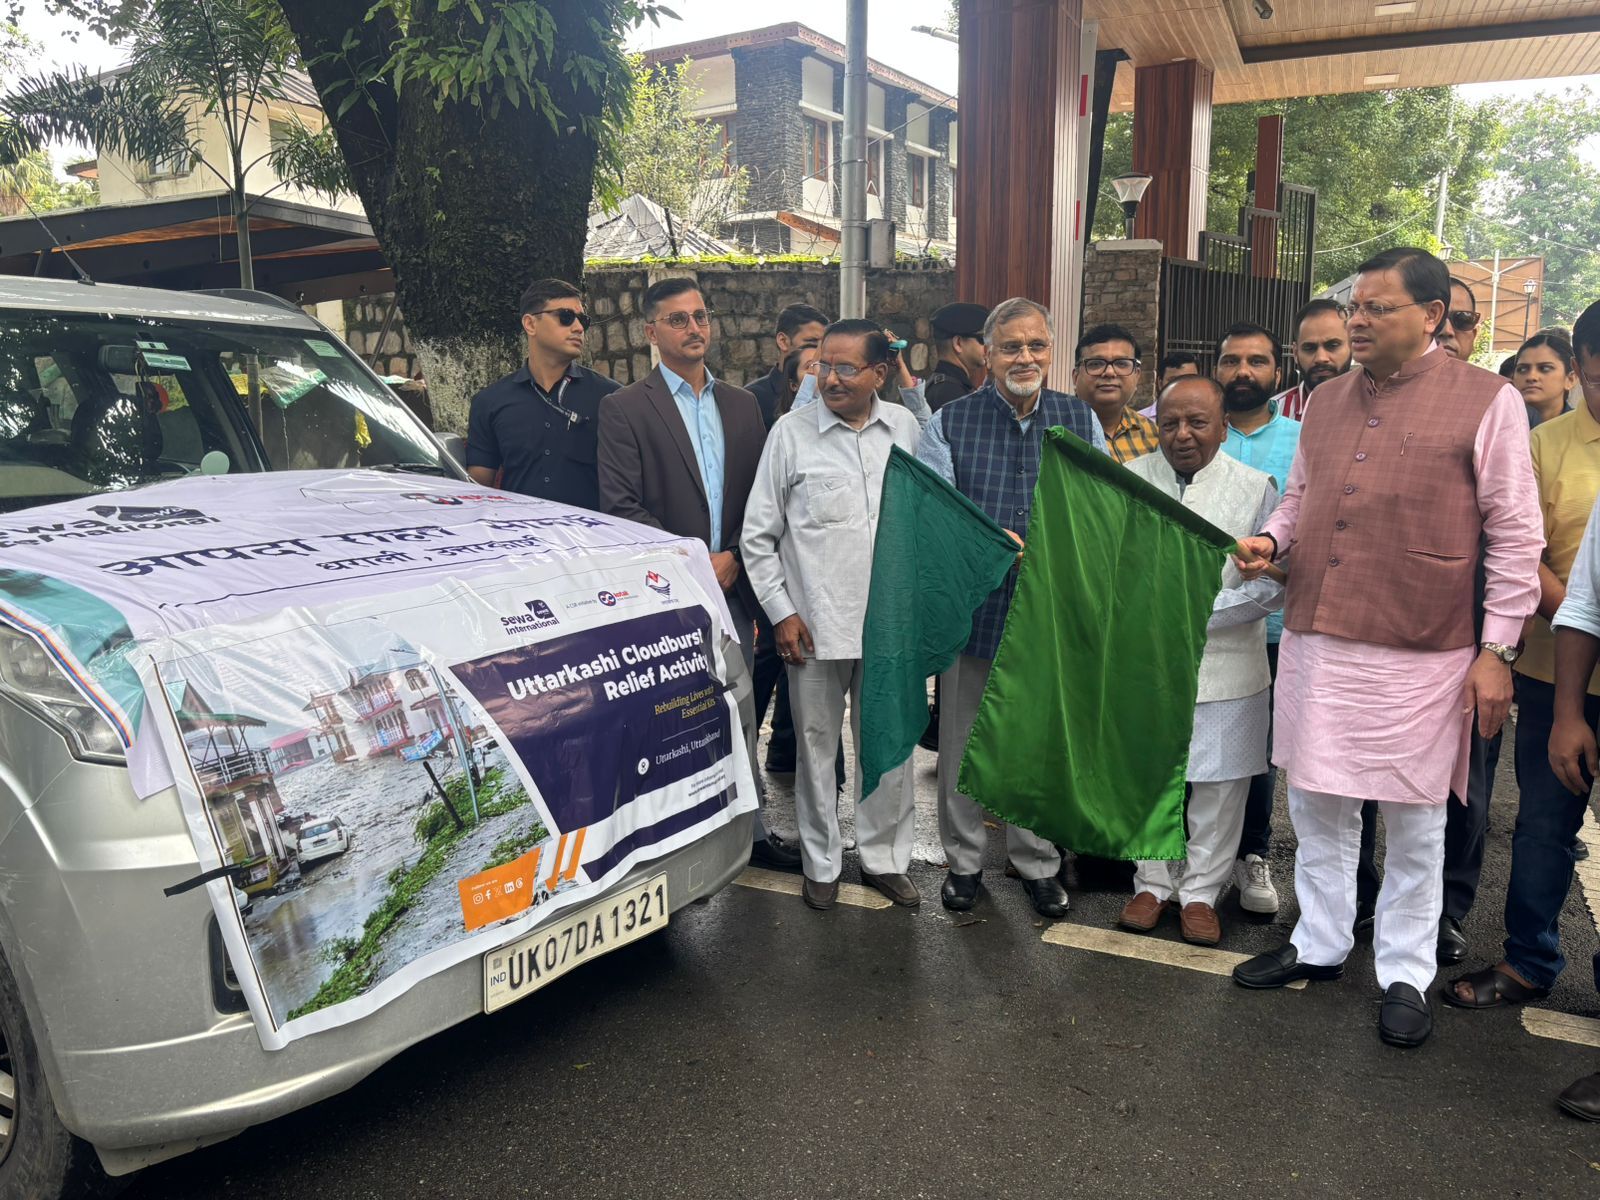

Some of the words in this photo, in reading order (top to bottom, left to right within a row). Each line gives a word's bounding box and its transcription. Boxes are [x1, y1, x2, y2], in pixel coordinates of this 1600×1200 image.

[98, 537, 320, 576] आपदा
[319, 525, 458, 546] राहत
[505, 617, 559, 635] International
[506, 649, 621, 700] Uttarkashi
[603, 666, 657, 700] Relief
[659, 652, 709, 684] Activity
[654, 696, 690, 715] Rebuilding
[689, 688, 706, 701] Lives
[681, 702, 708, 719] Essential
[508, 884, 665, 990] UK07DA1321
[490, 971, 507, 987] IND
